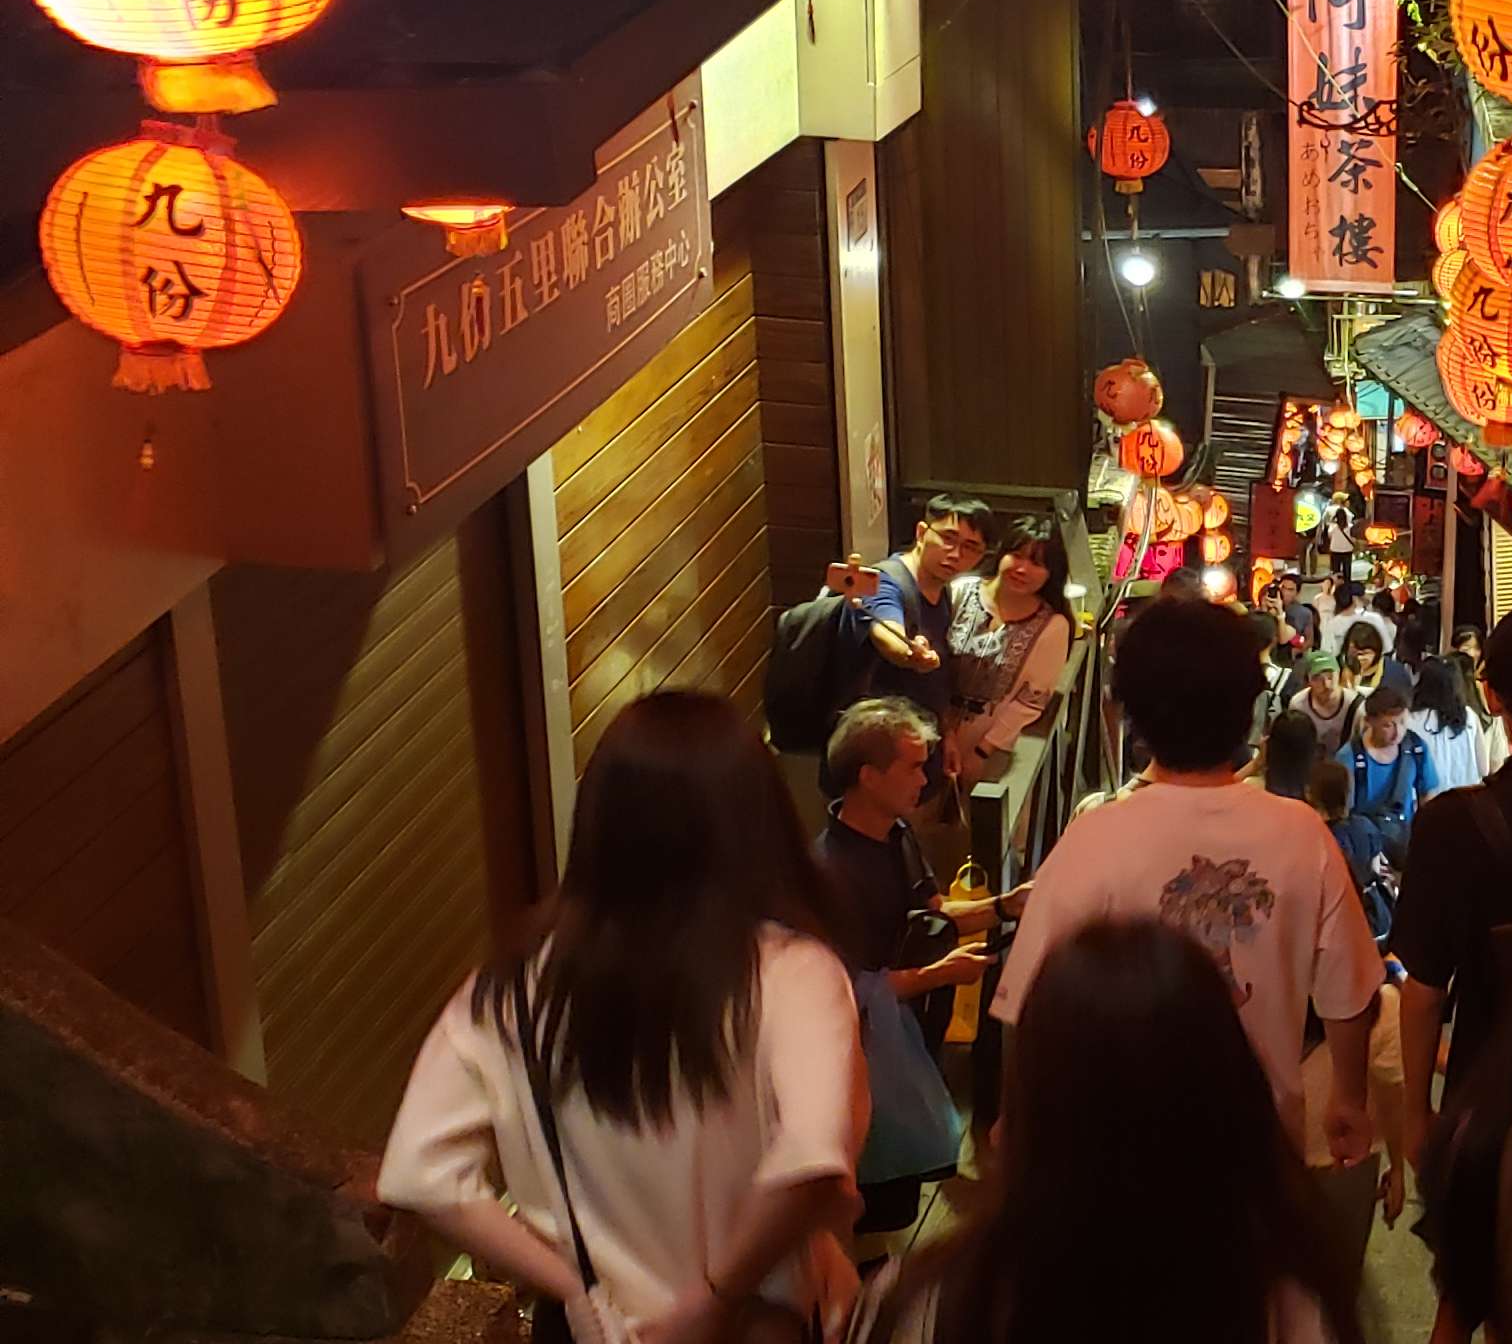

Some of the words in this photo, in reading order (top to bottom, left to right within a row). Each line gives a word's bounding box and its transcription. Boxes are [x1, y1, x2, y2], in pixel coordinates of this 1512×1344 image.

[1128, 125, 1149, 170] 九份
[133, 182, 205, 321] 九份
[1467, 286, 1500, 368] 九份
